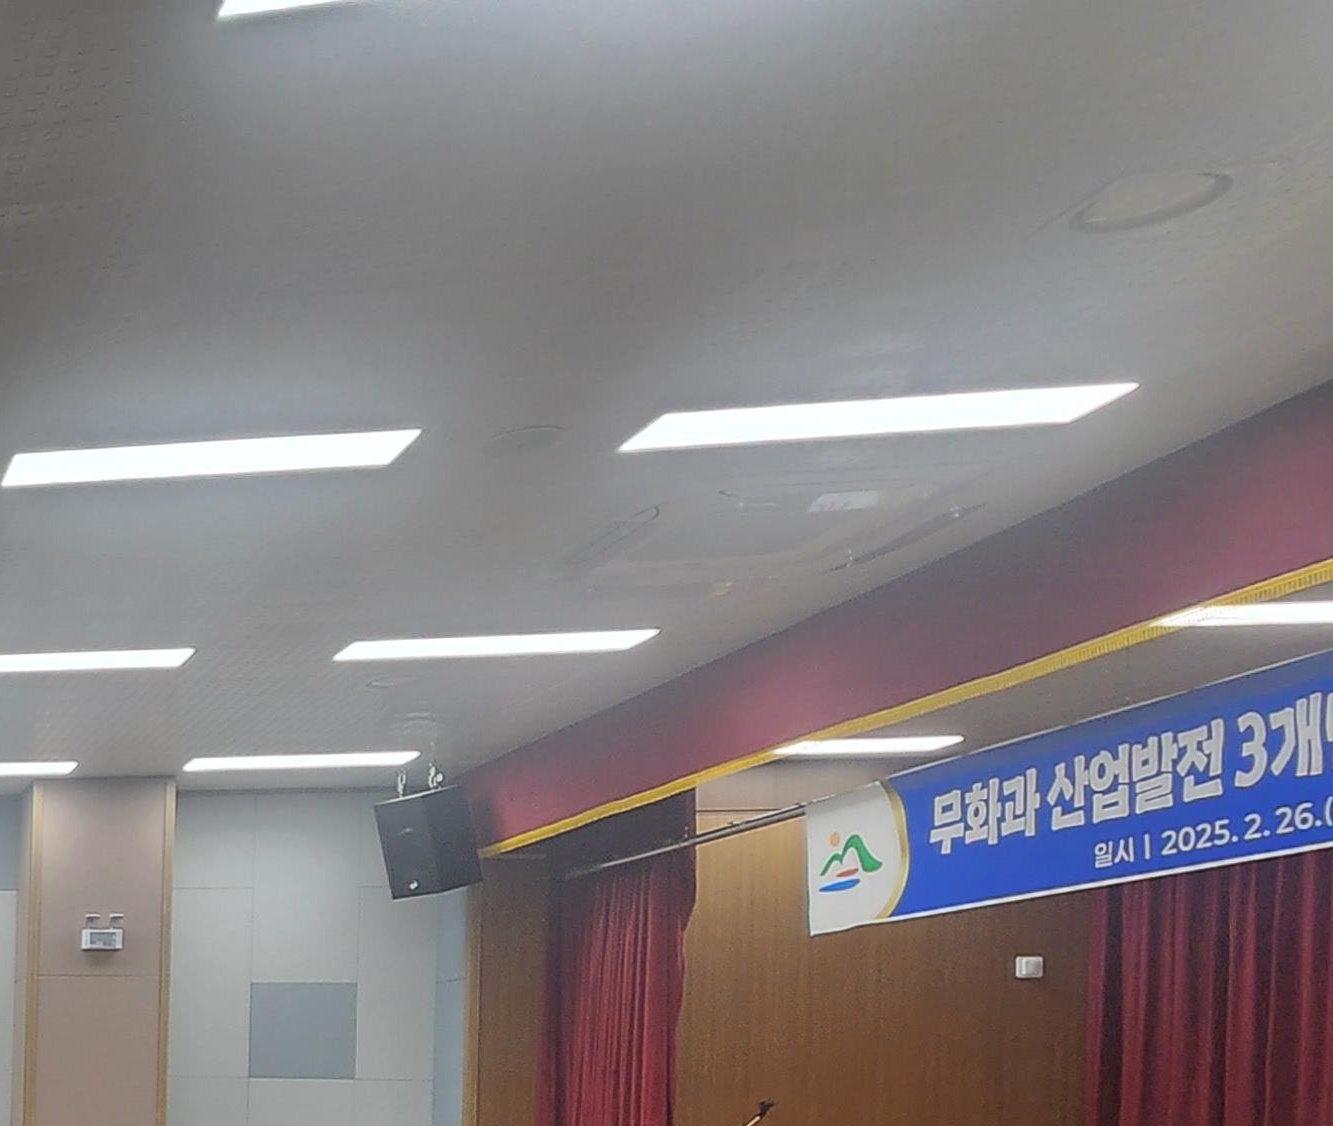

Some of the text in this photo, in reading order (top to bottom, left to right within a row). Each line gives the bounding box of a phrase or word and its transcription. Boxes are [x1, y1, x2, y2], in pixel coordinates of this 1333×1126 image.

[929, 691, 1333, 855] 무화과 산업발전 3개
[1094, 836, 1135, 868] 일시
[1161, 819, 1239, 856] 2025.
[1244, 813, 1271, 841] 2.
